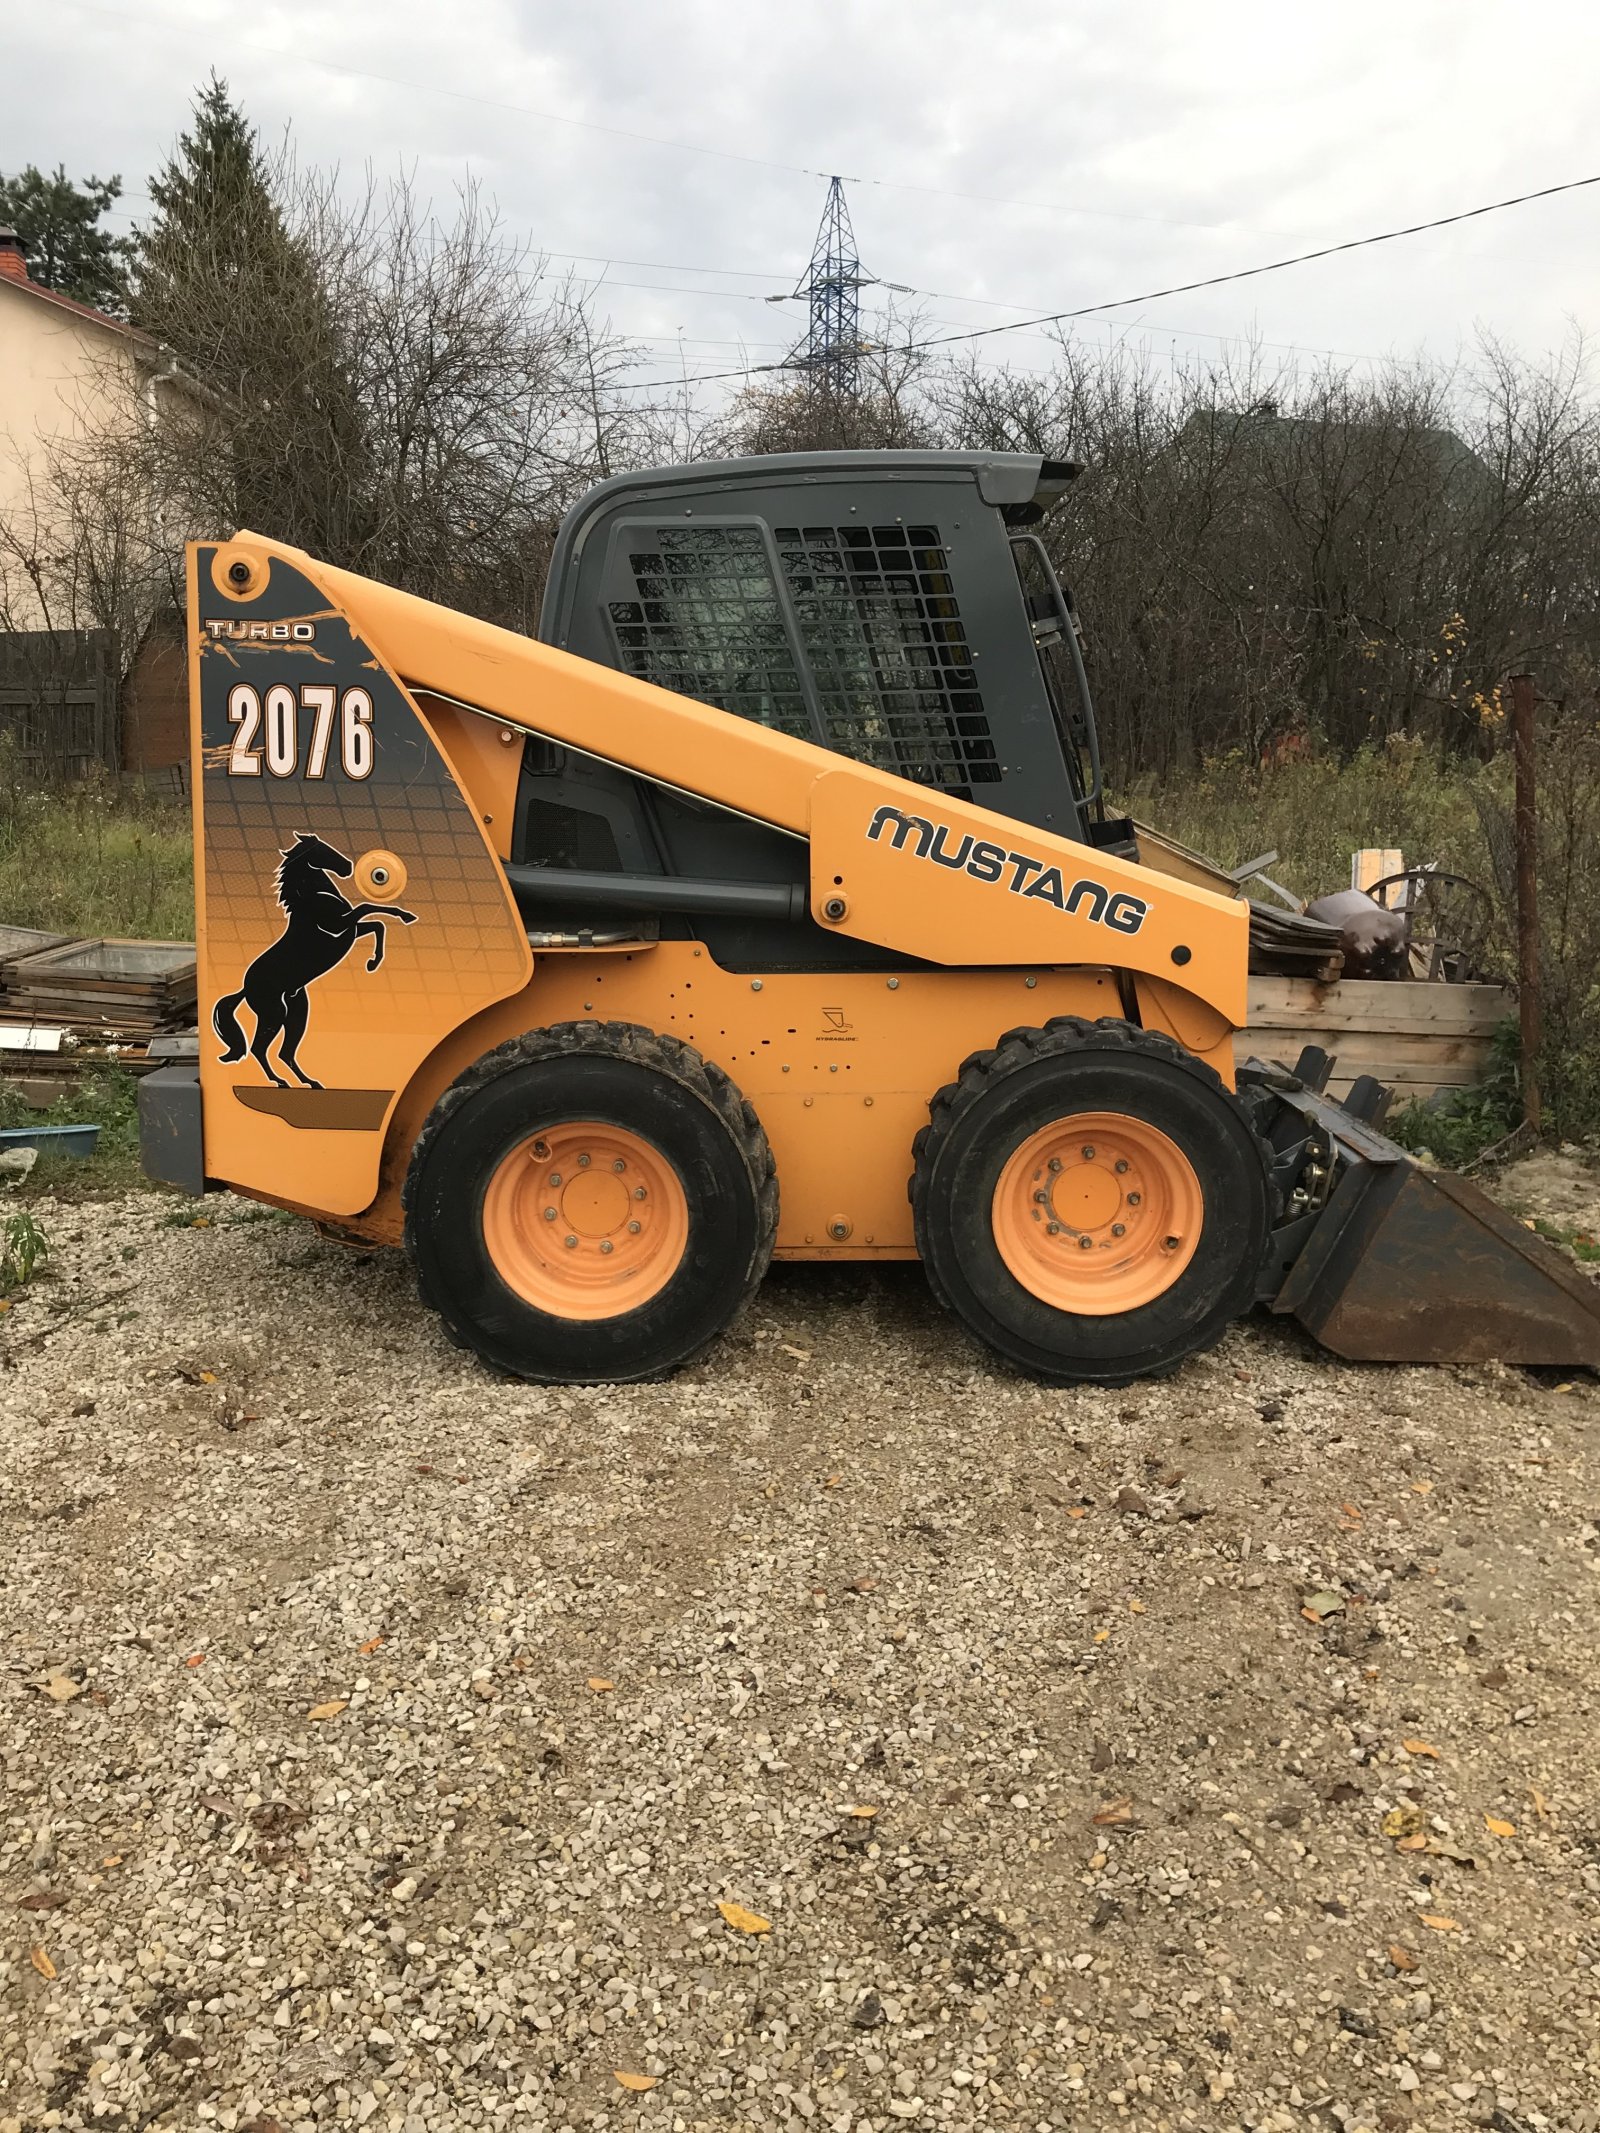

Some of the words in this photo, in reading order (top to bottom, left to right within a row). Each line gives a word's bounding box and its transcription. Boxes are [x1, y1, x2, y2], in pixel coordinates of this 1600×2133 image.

[205, 619, 316, 641] TURBO
[228, 683, 375, 781] 2076
[866, 805, 1148, 936] MUSTANG
